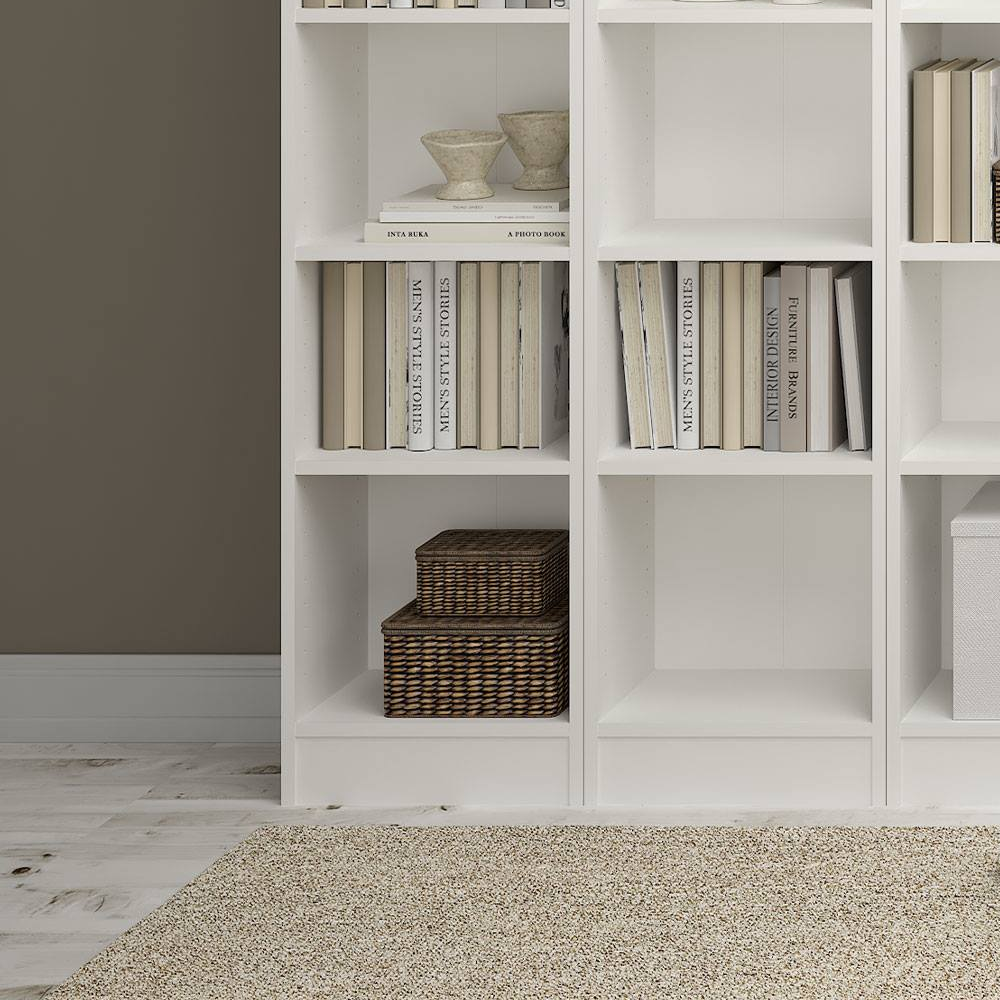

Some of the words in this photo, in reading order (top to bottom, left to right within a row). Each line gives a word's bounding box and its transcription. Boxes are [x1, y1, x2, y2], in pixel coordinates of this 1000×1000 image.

[412, 279, 423, 325] MEN'S
[439, 277, 451, 339] STORIES
[683, 277, 694, 338] STORIES
[412, 326, 423, 373] STYLE
[765, 306, 779, 356] DESIGN
[788, 296, 800, 364] FURNITURE
[439, 340, 451, 387] STYLE
[683, 340, 694, 387] STYLE
[412, 374, 423, 435] STORIES
[439, 389, 451, 433] MEN'S
[683, 389, 694, 433] MEN'S
[765, 358, 779, 423] INTERIOR
[788, 371, 800, 420] BRANDS
